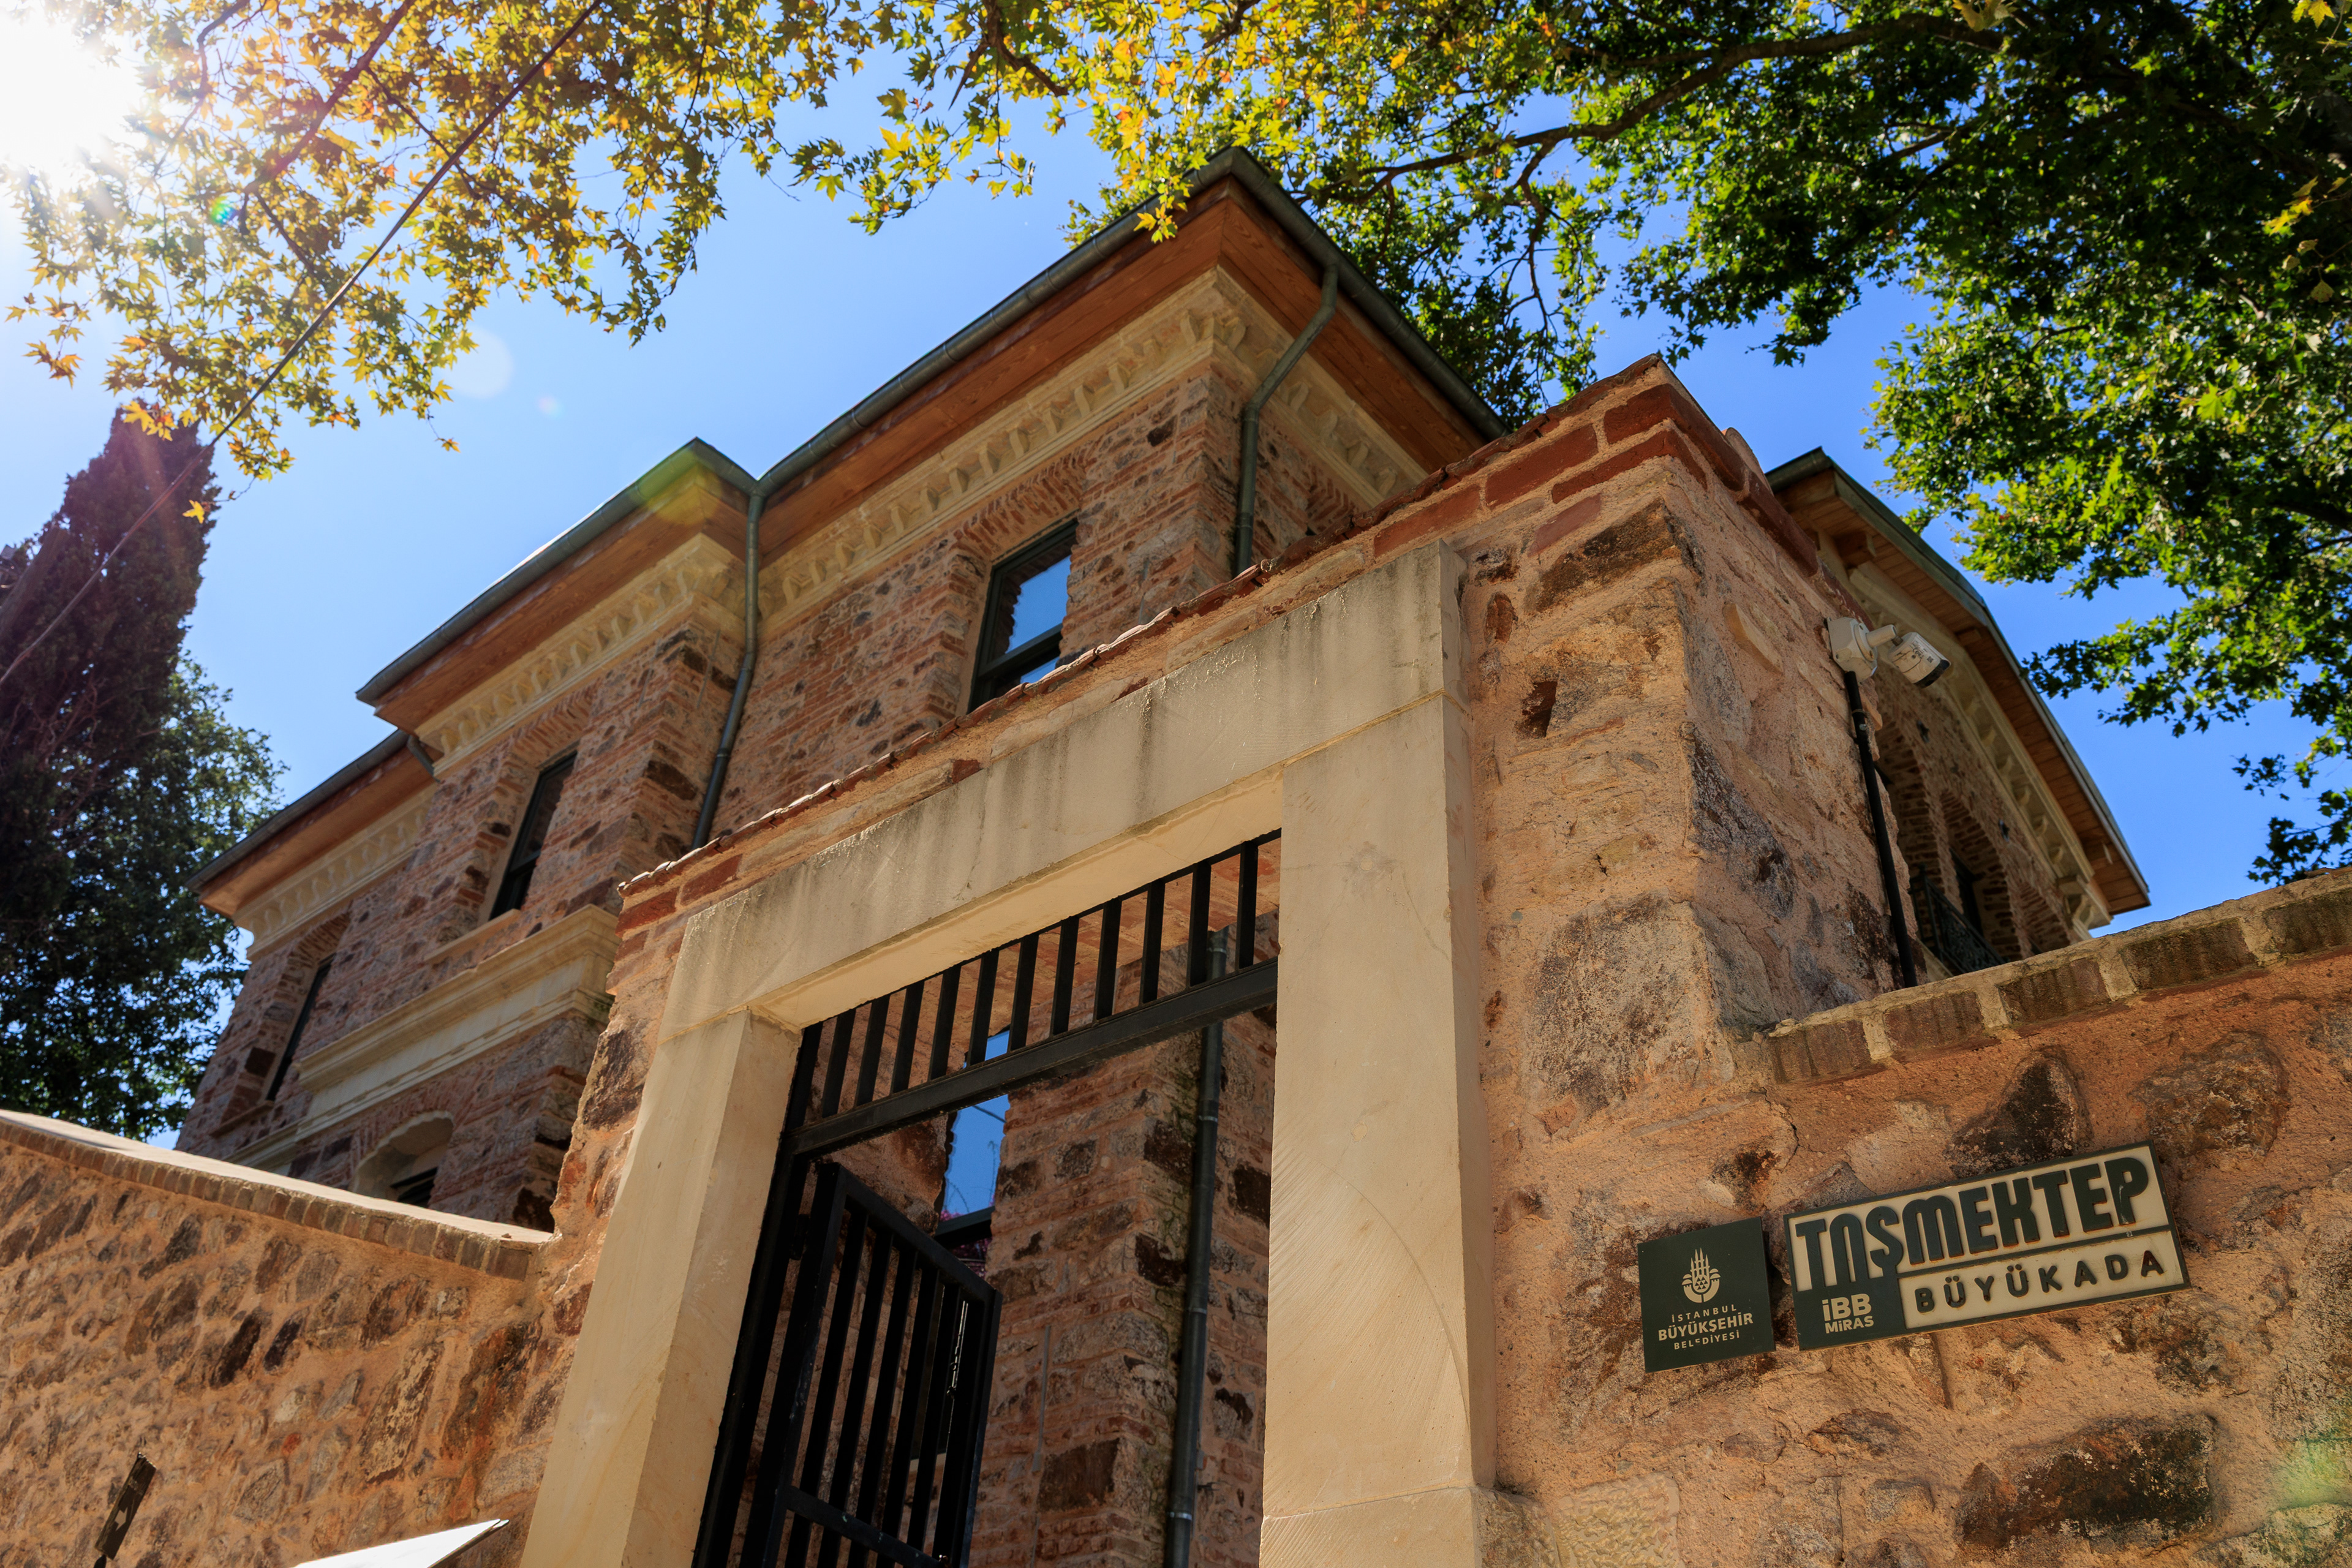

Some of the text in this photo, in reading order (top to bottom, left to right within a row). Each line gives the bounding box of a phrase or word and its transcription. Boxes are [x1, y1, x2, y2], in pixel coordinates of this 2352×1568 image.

[1914, 1250, 2165, 1313] BÜYÜKADA
[1657, 1312, 1754, 1341] BÜYÜKŞEHİR
[1672, 1303, 1737, 1323] İSTANBUL
